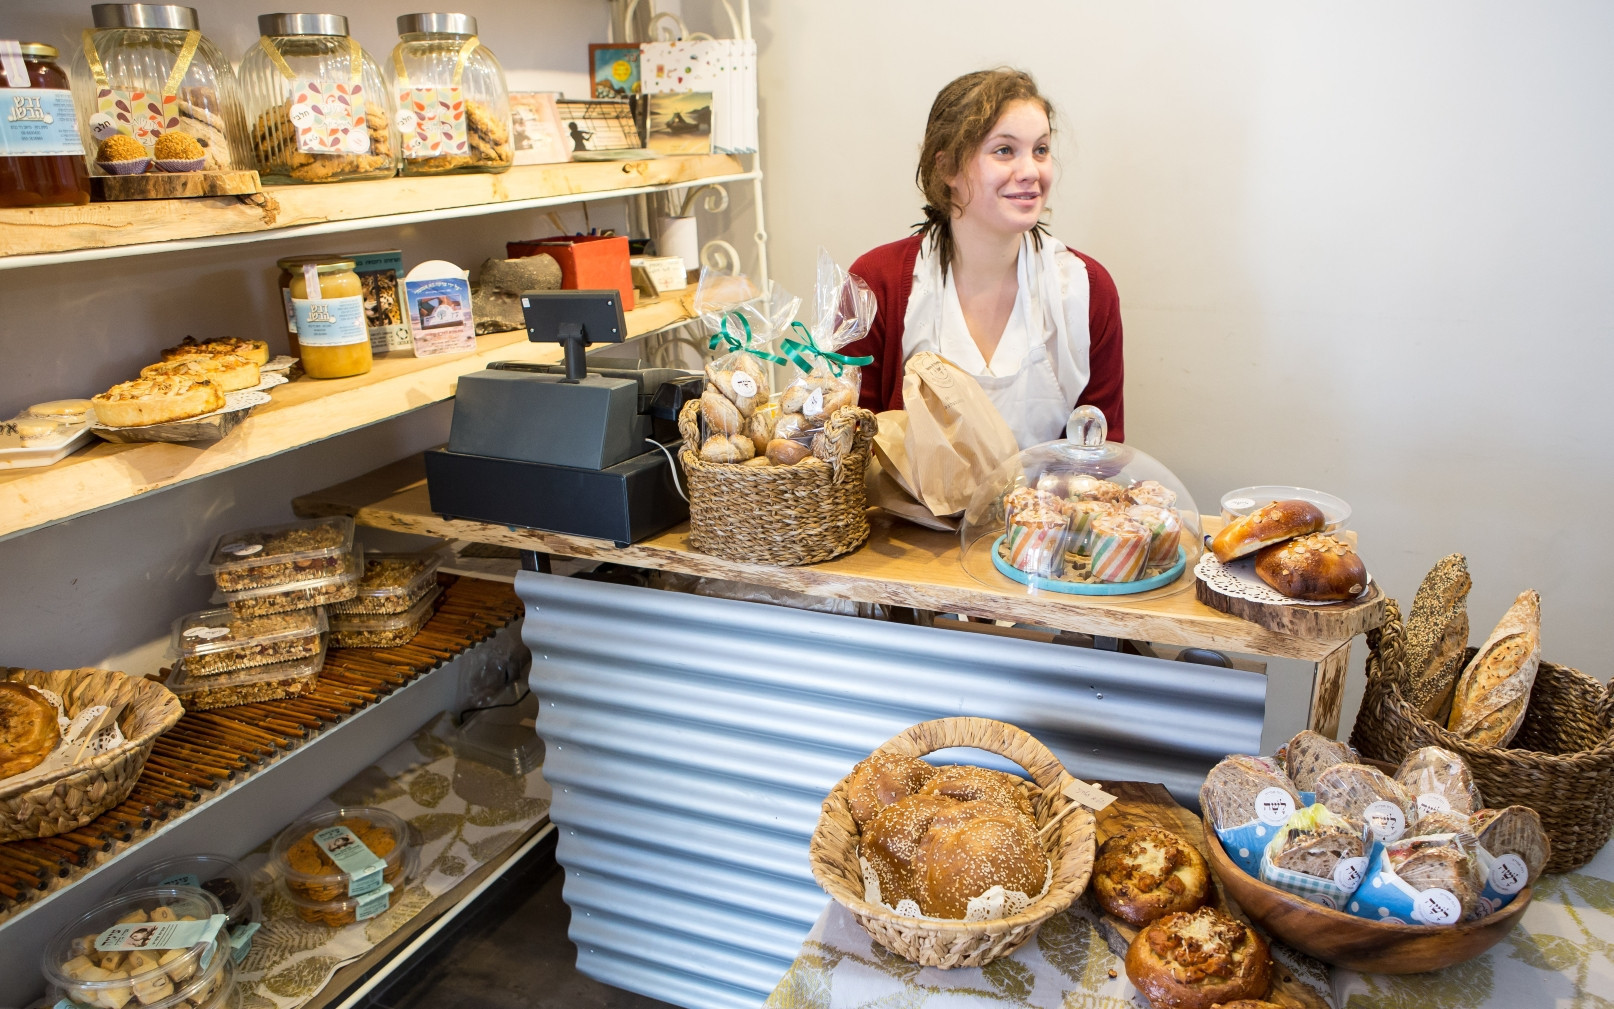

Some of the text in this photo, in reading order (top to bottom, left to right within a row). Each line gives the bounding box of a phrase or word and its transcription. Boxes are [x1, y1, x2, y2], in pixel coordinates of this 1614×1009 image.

[13, 96, 42, 108] דבש
[293, 110, 310, 121] חלבי
[93, 120, 111, 133] חלבי
[309, 304, 328, 315] דבש
